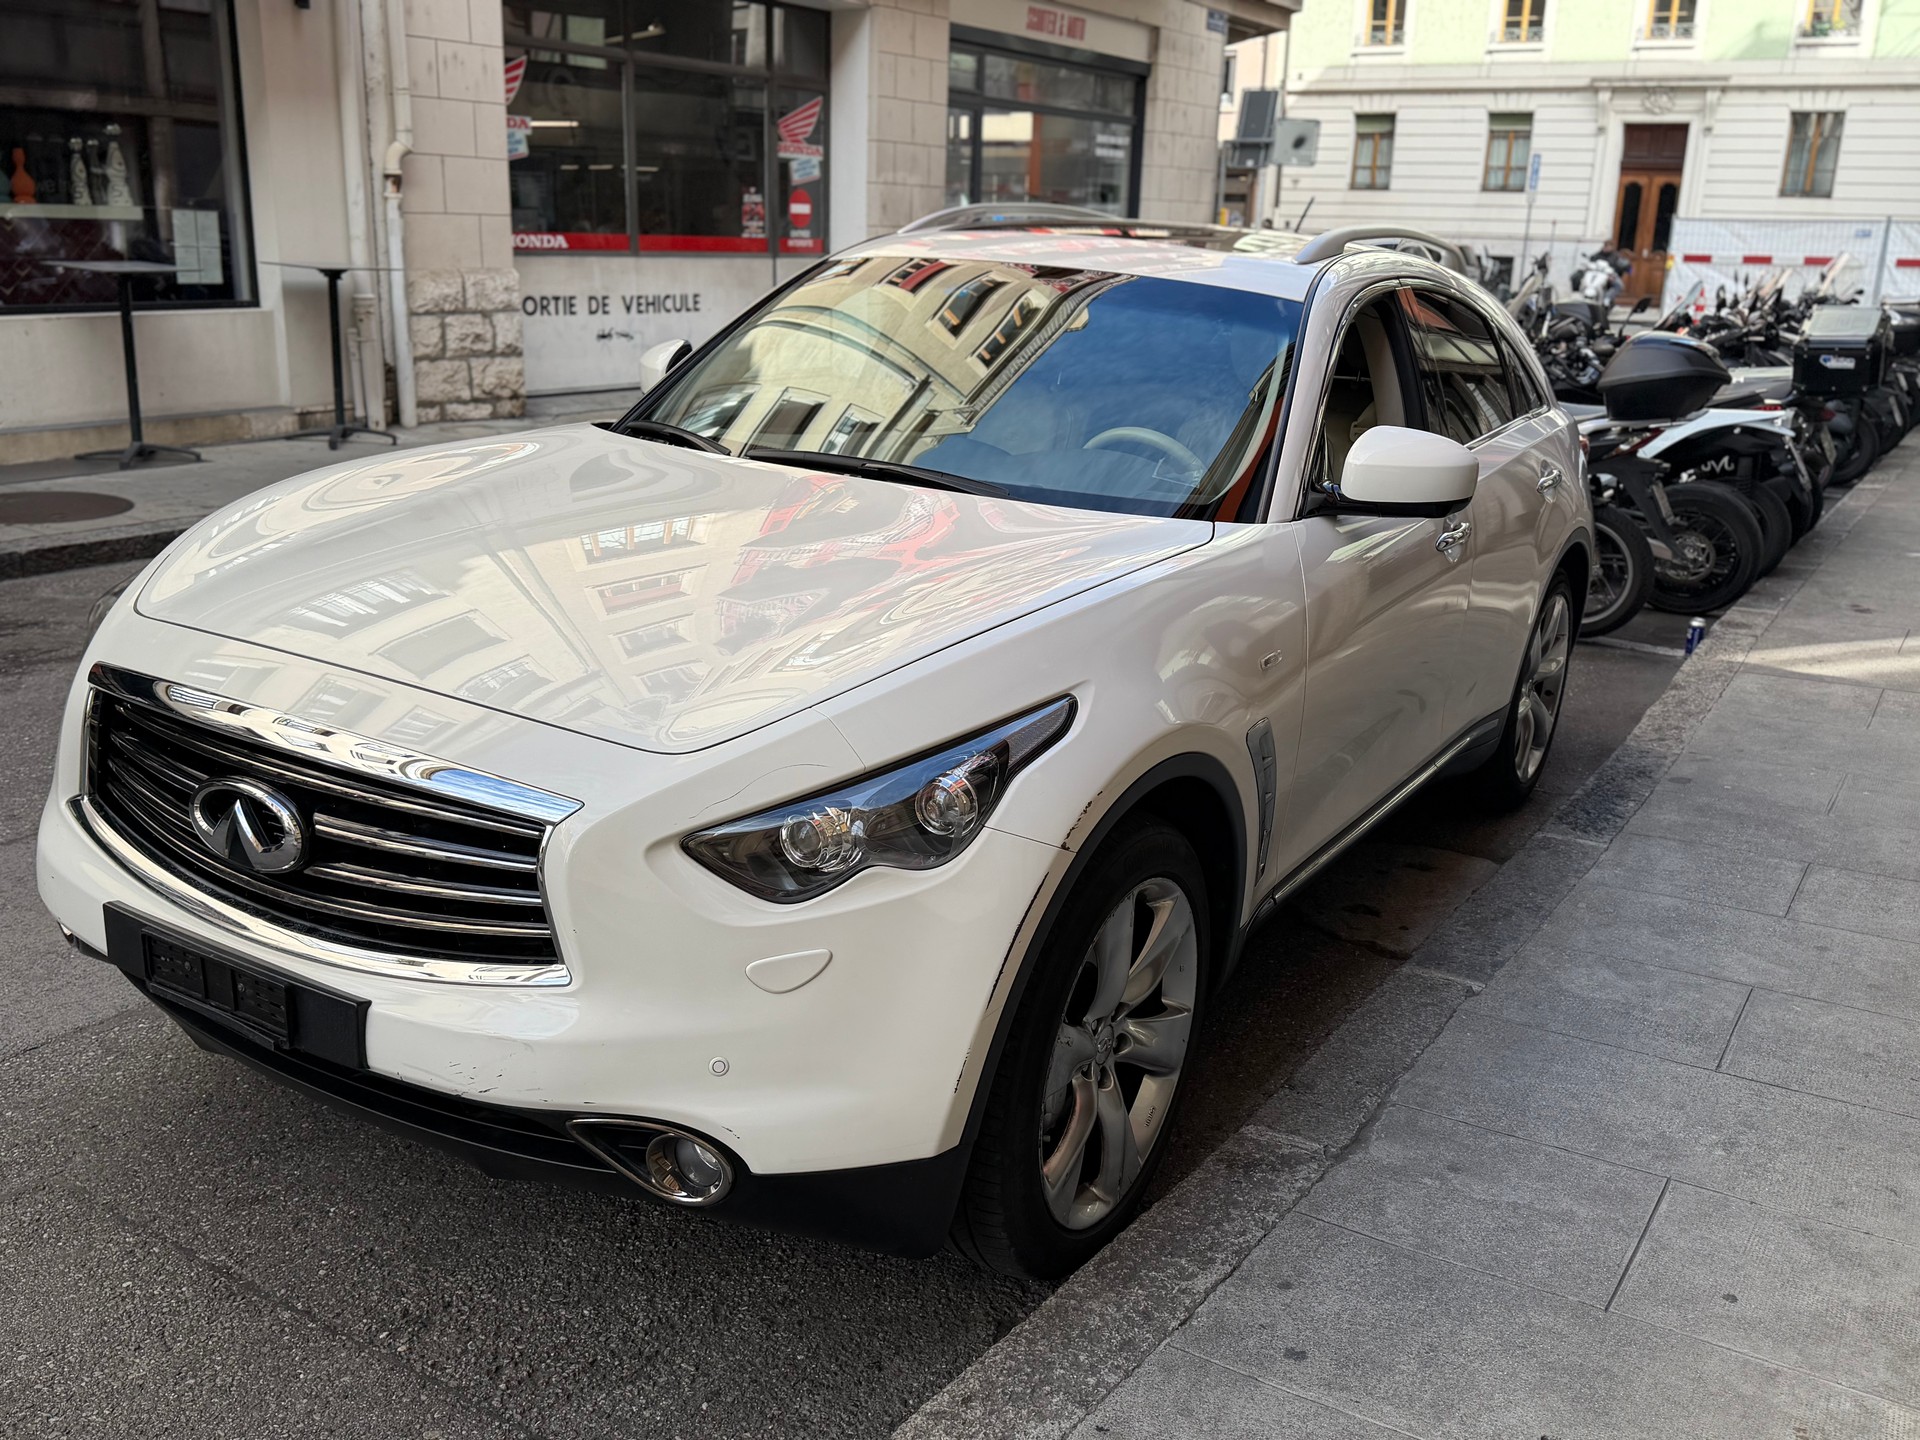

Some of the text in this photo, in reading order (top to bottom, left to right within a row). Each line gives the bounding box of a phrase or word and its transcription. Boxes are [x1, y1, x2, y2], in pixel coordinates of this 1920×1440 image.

[522, 293, 701, 316] ORTIE DE VEHICULE
